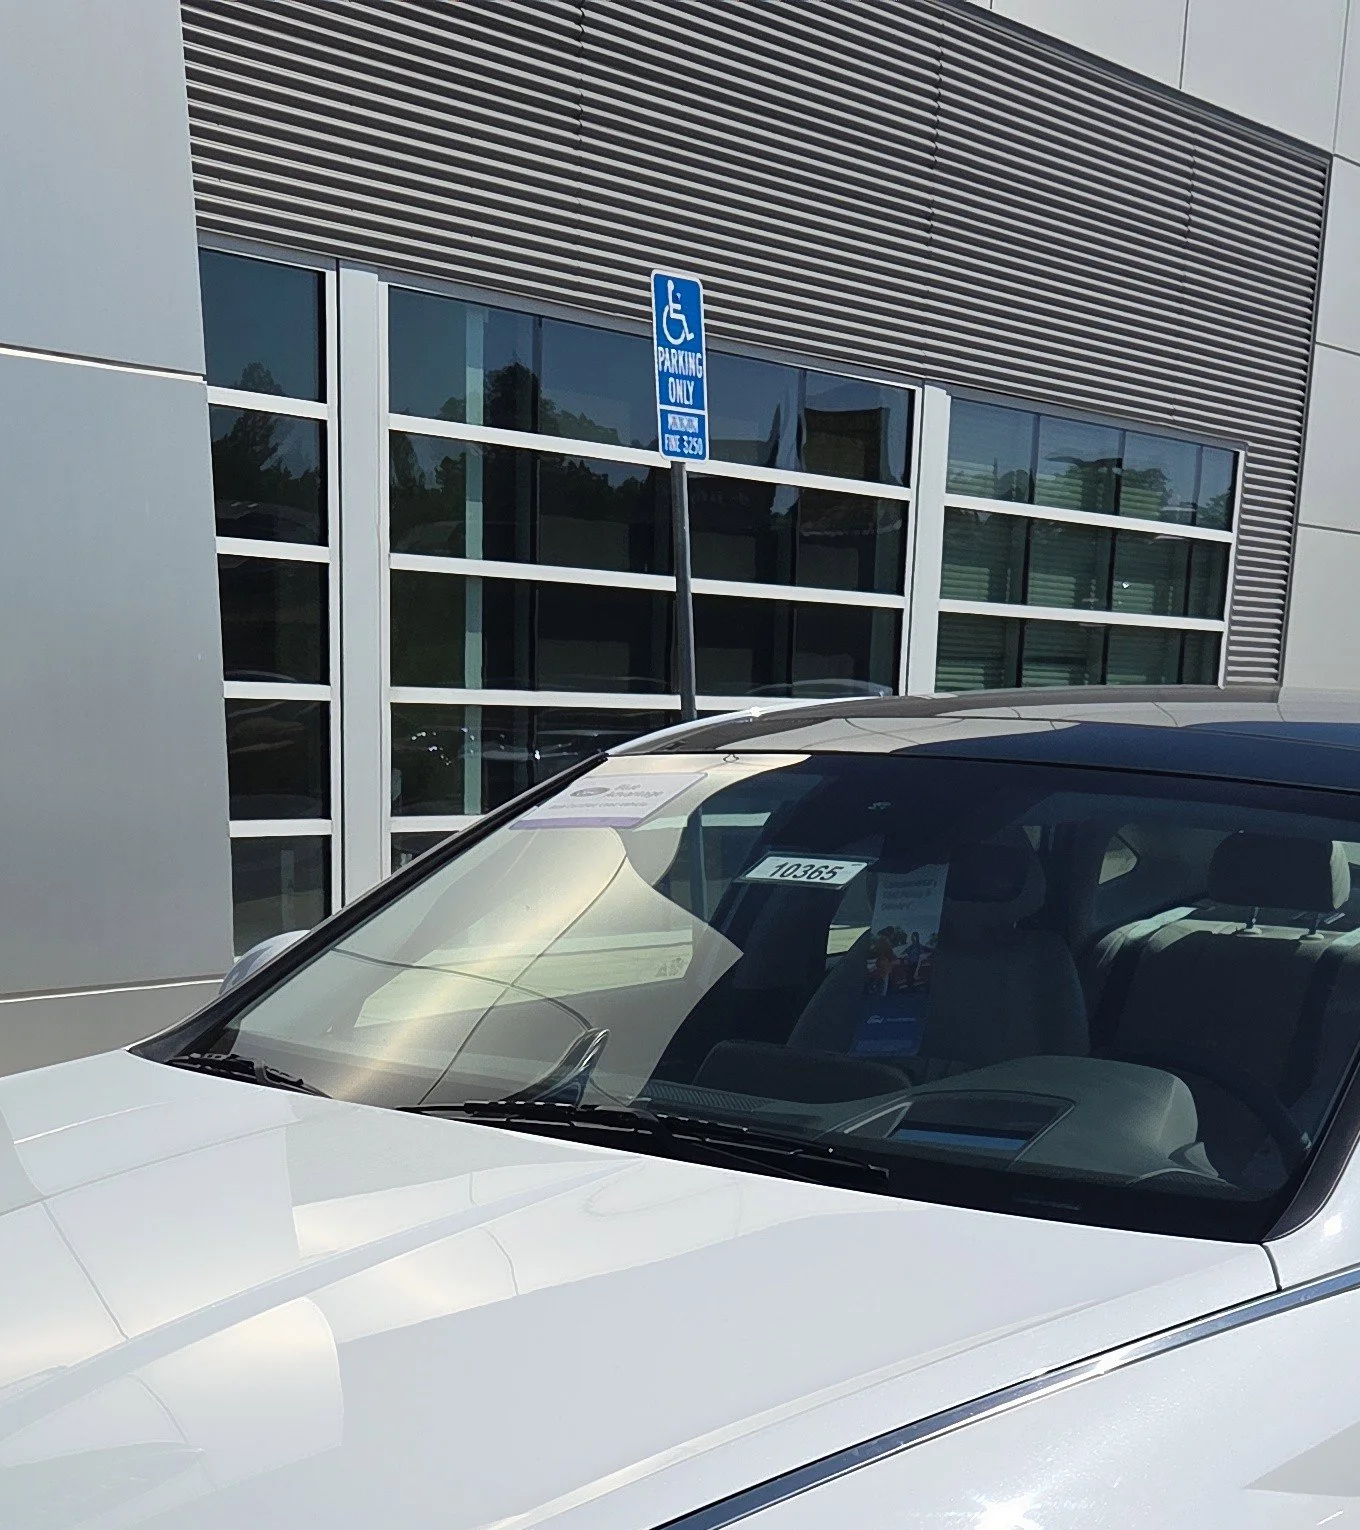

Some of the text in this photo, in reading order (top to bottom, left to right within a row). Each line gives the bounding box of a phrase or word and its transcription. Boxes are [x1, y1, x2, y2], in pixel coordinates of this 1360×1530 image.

[657, 346, 703, 379] PARKING
[668, 377, 695, 405] ONLY
[664, 434, 704, 456] FINE $250
[769, 861, 845, 884] 10365
